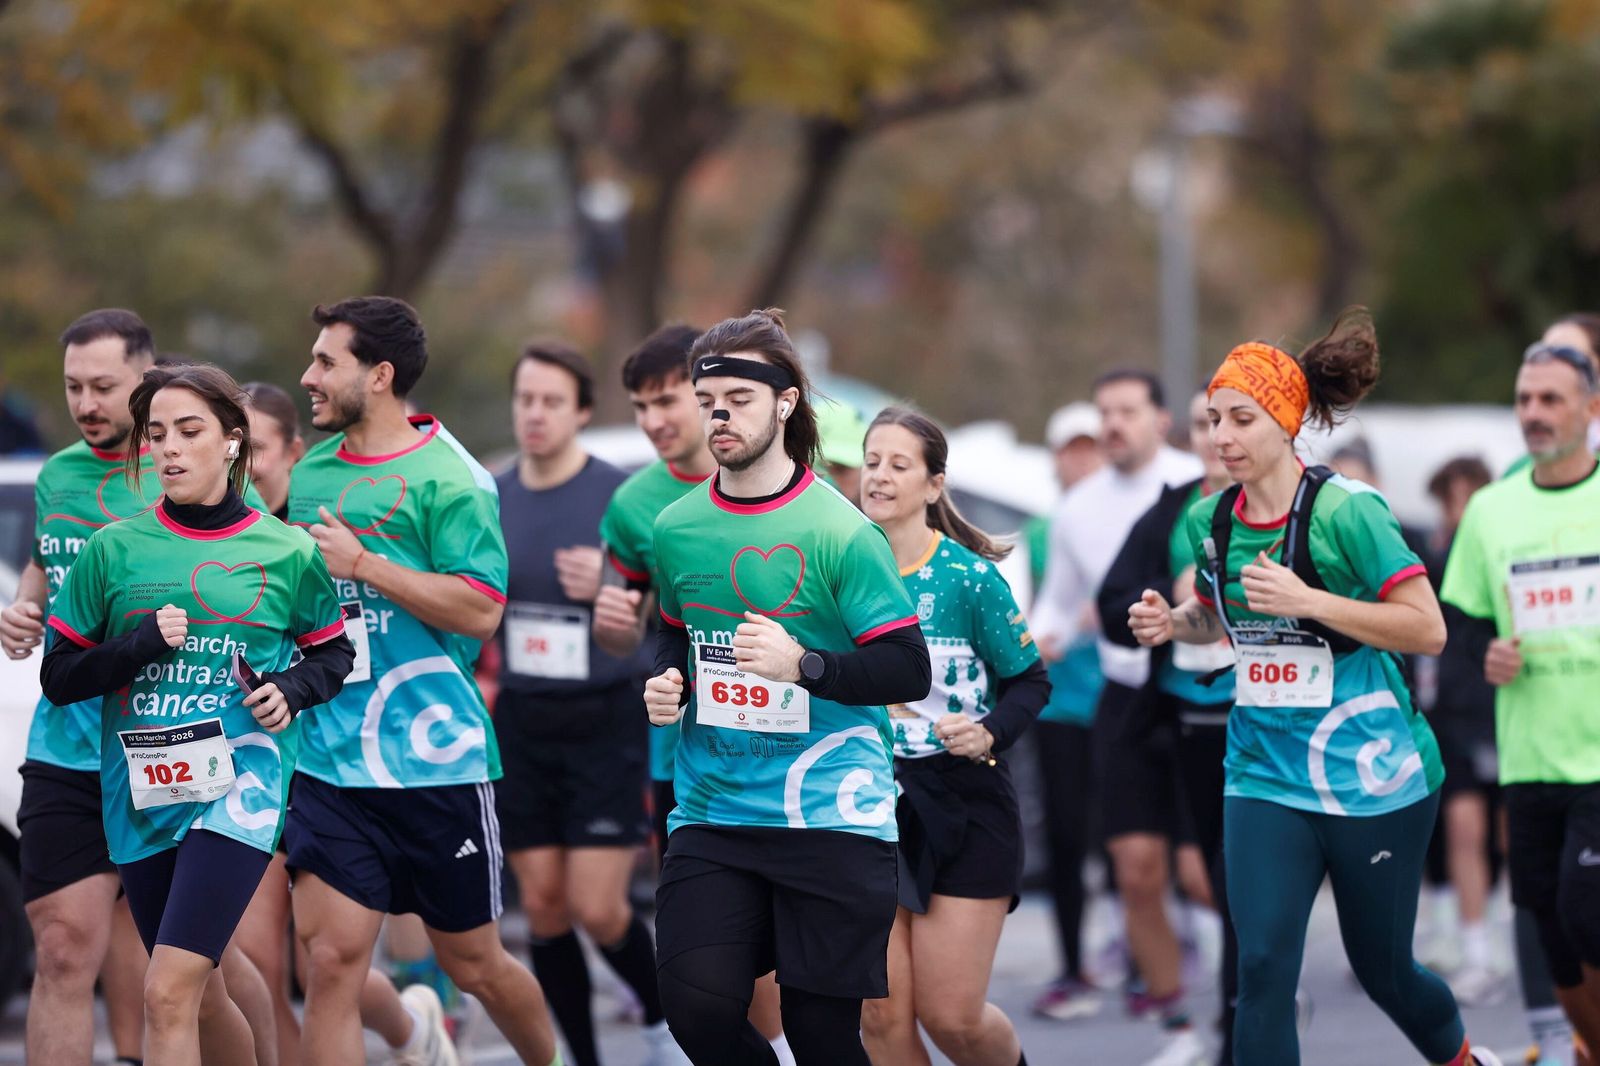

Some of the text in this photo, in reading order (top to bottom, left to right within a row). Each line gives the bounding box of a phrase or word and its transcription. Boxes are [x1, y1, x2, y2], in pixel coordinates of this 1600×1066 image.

[40, 533, 61, 556] En
[173, 634, 248, 659] archa
[714, 649, 724, 657] En
[703, 667, 746, 679] #YoCorroPor
[1248, 662, 1299, 684] 606
[132, 684, 232, 718] cáncer
[711, 681, 770, 708] 639
[143, 733, 167, 742] Marcha
[171, 729, 194, 742] 2026
[143, 761, 194, 785] 102
